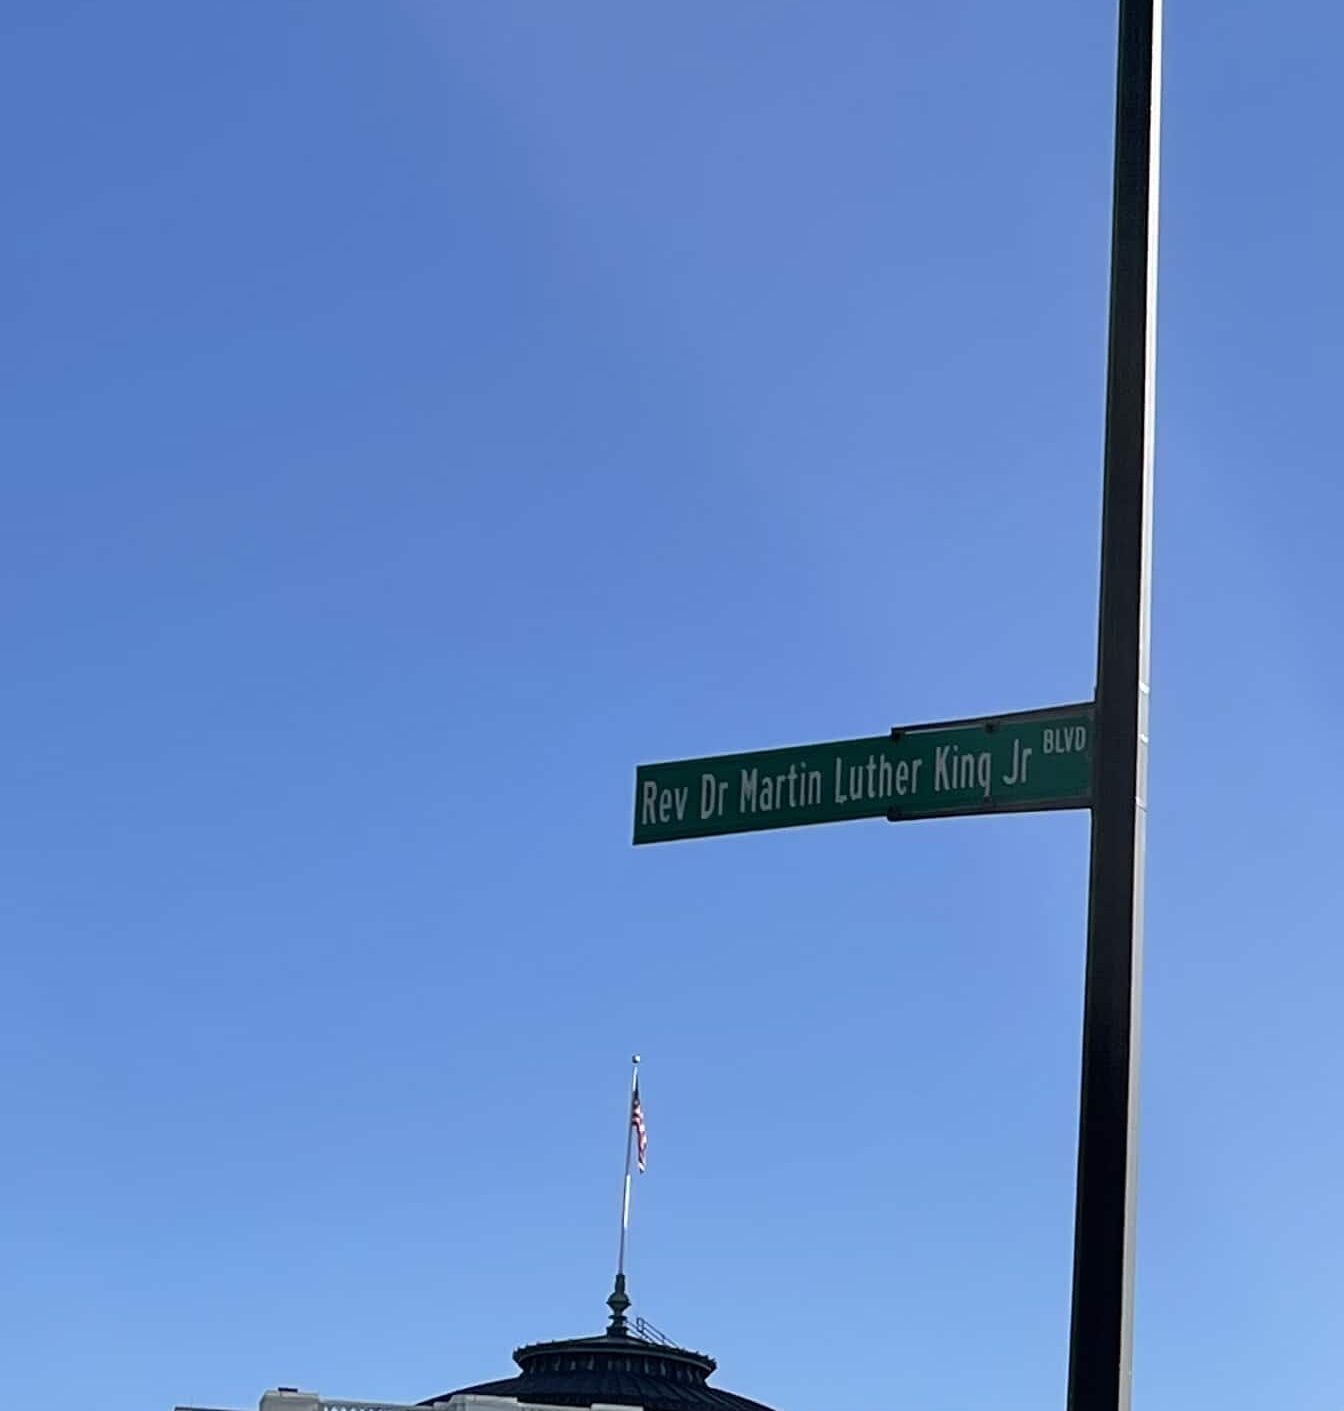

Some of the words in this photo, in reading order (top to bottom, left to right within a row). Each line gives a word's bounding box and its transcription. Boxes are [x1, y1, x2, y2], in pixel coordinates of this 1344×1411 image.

[641, 781, 689, 825] Rev
[700, 773, 728, 820] Dr
[739, 762, 822, 813] Martin
[835, 755, 923, 803] Luther
[934, 745, 991, 796] King
[1002, 738, 1032, 785] Jr
[1043, 726, 1087, 754] BLVD
